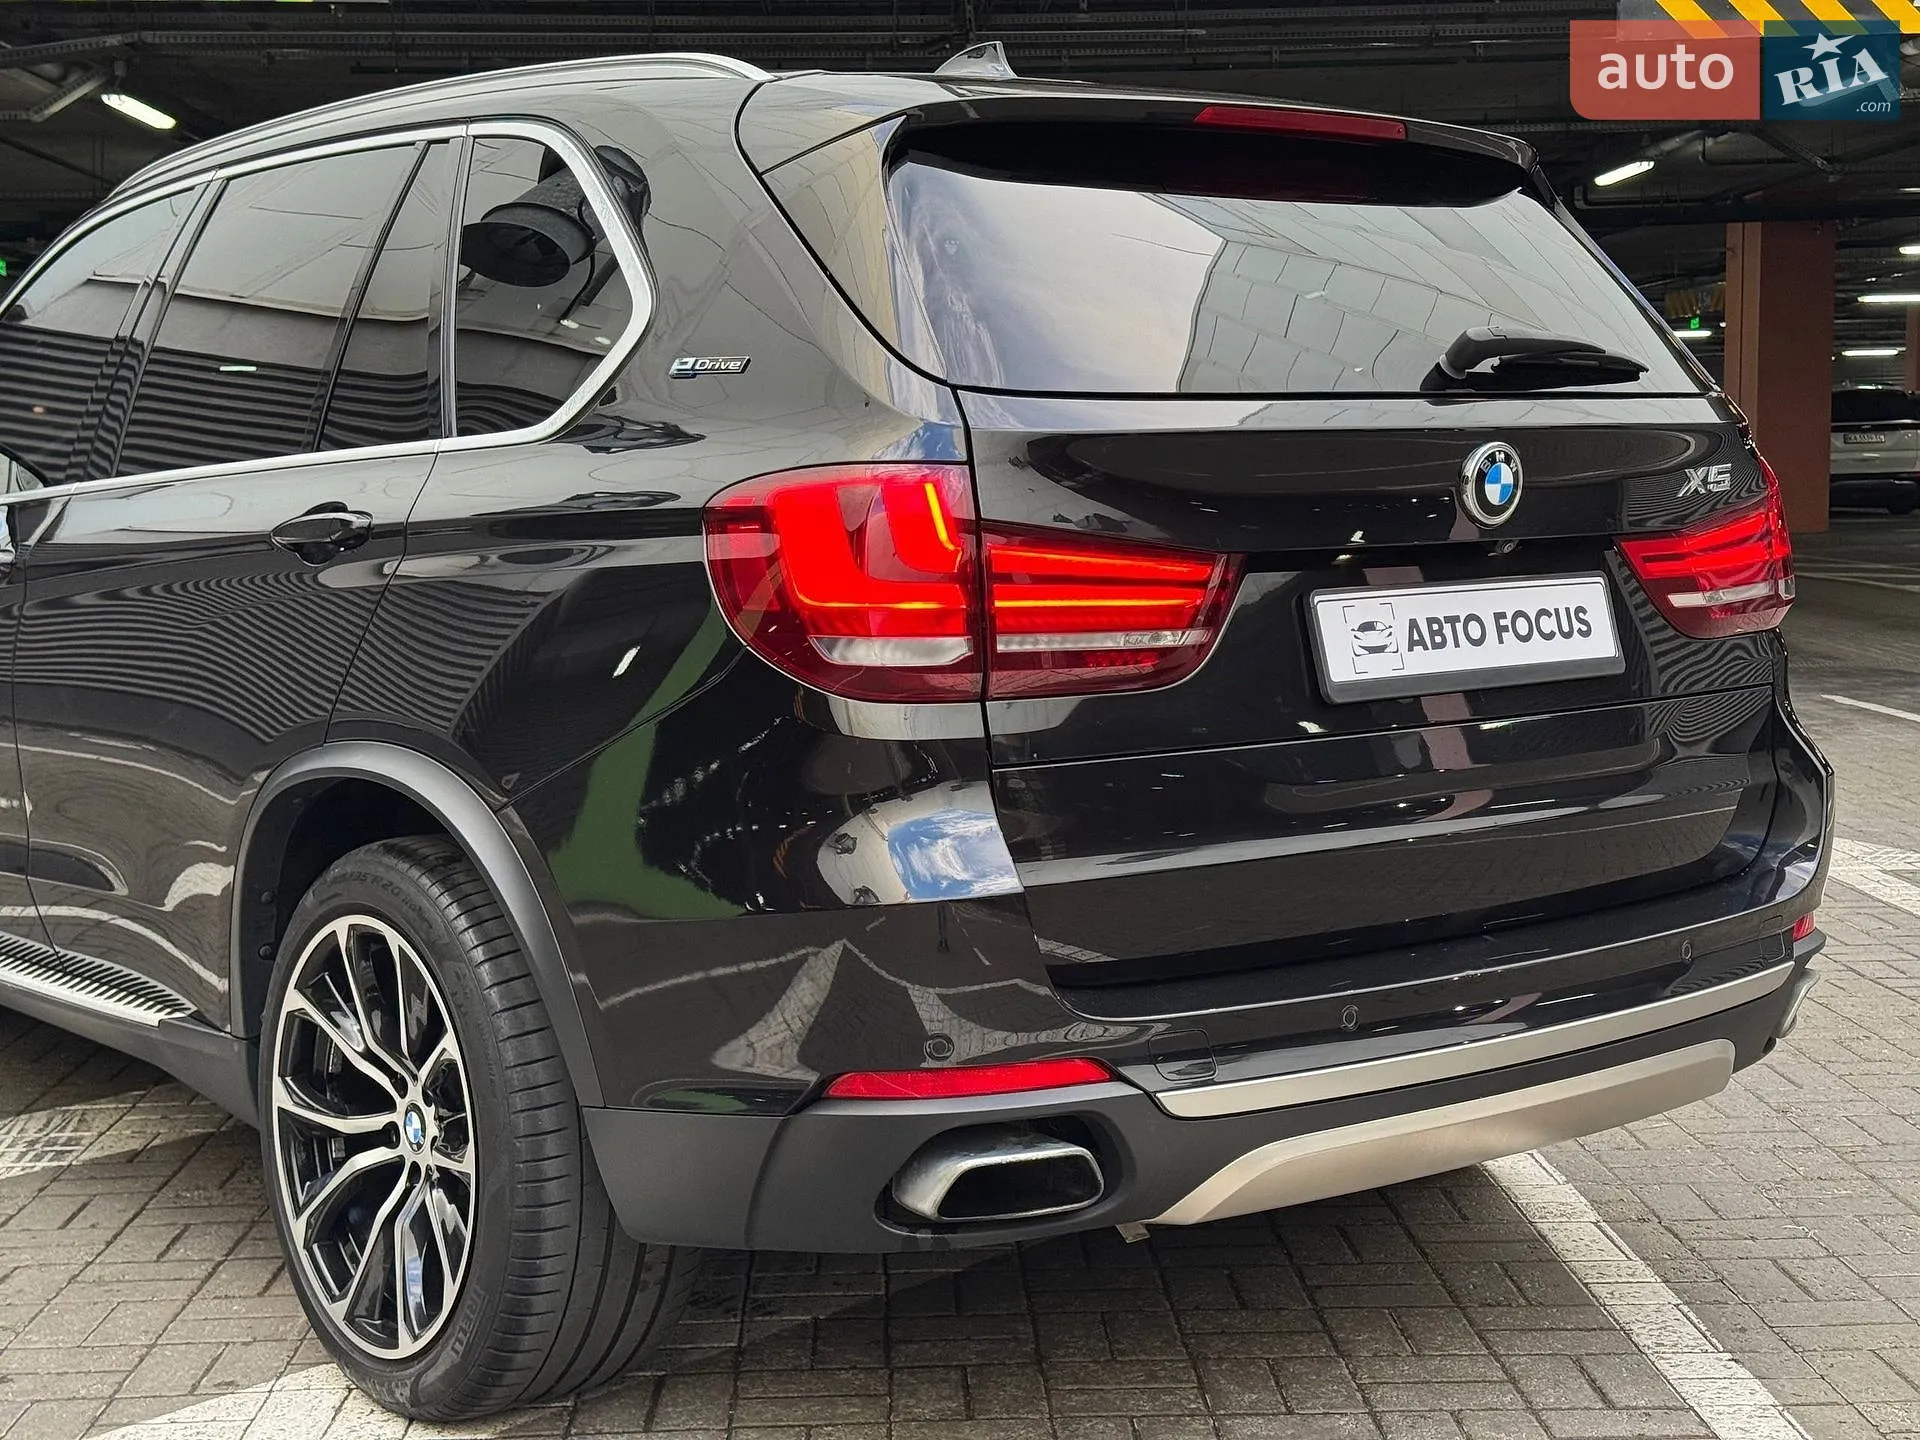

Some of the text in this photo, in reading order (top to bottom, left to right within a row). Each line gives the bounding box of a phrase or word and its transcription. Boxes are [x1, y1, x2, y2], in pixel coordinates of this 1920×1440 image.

[1480, 451, 1518, 473] BMW
[1677, 463, 1732, 497] X5
[1493, 605, 1593, 645] FOCUS
